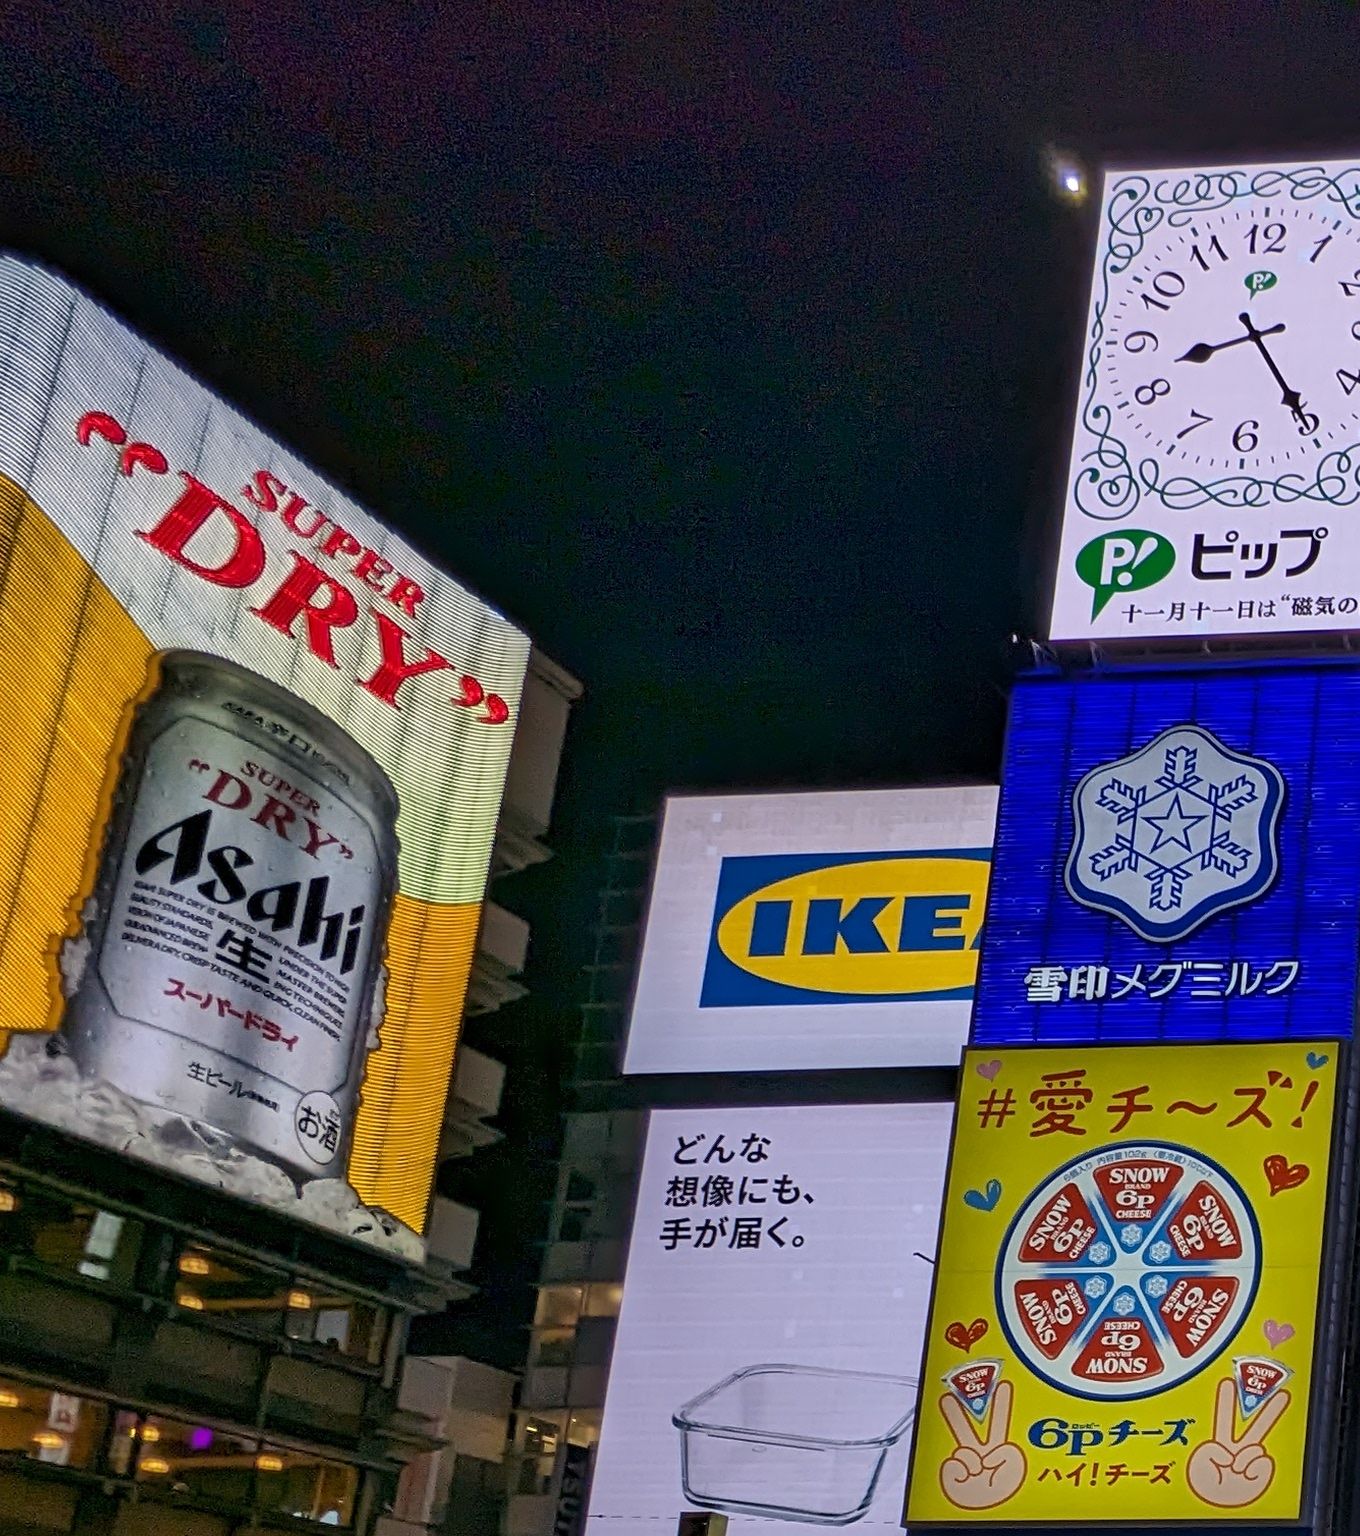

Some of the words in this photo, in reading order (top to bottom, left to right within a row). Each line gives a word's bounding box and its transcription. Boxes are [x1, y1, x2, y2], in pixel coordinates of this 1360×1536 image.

[1189, 235, 1230, 272] 11
[1244, 222, 1287, 255] 12
[1310, 235, 1333, 265] 1
[1140, 271, 1185, 312] 10
[1124, 331, 1159, 354] 9
[1134, 379, 1171, 405] 8
[1176, 409, 1214, 440] 7
[1291, 402, 1321, 436] 5
[1232, 420, 1259, 453] 6
[241, 470, 426, 619] SUPER
[1190, 526, 1329, 581] ピップ
[240, 761, 320, 816] SUPER
[136, 808, 365, 977] Asahi
[748, 894, 984, 958] IKE
[214, 929, 272, 985] 生
[1024, 961, 1299, 1003] 雪印メグミルク
[163, 978, 299, 1052] スーパードライ
[673, 1132, 771, 1164] どんな
[665, 1174, 815, 1208] 想像にも、
[1109, 1167, 1170, 1184] SNOW
[1029, 1194, 1073, 1251] SNOW
[1116, 1210, 1152, 1219] CHEESE
[1198, 1194, 1237, 1248] SNOW
[659, 1217, 806, 1251] 手が届く。
[1086, 1357, 1148, 1374] SNOW
